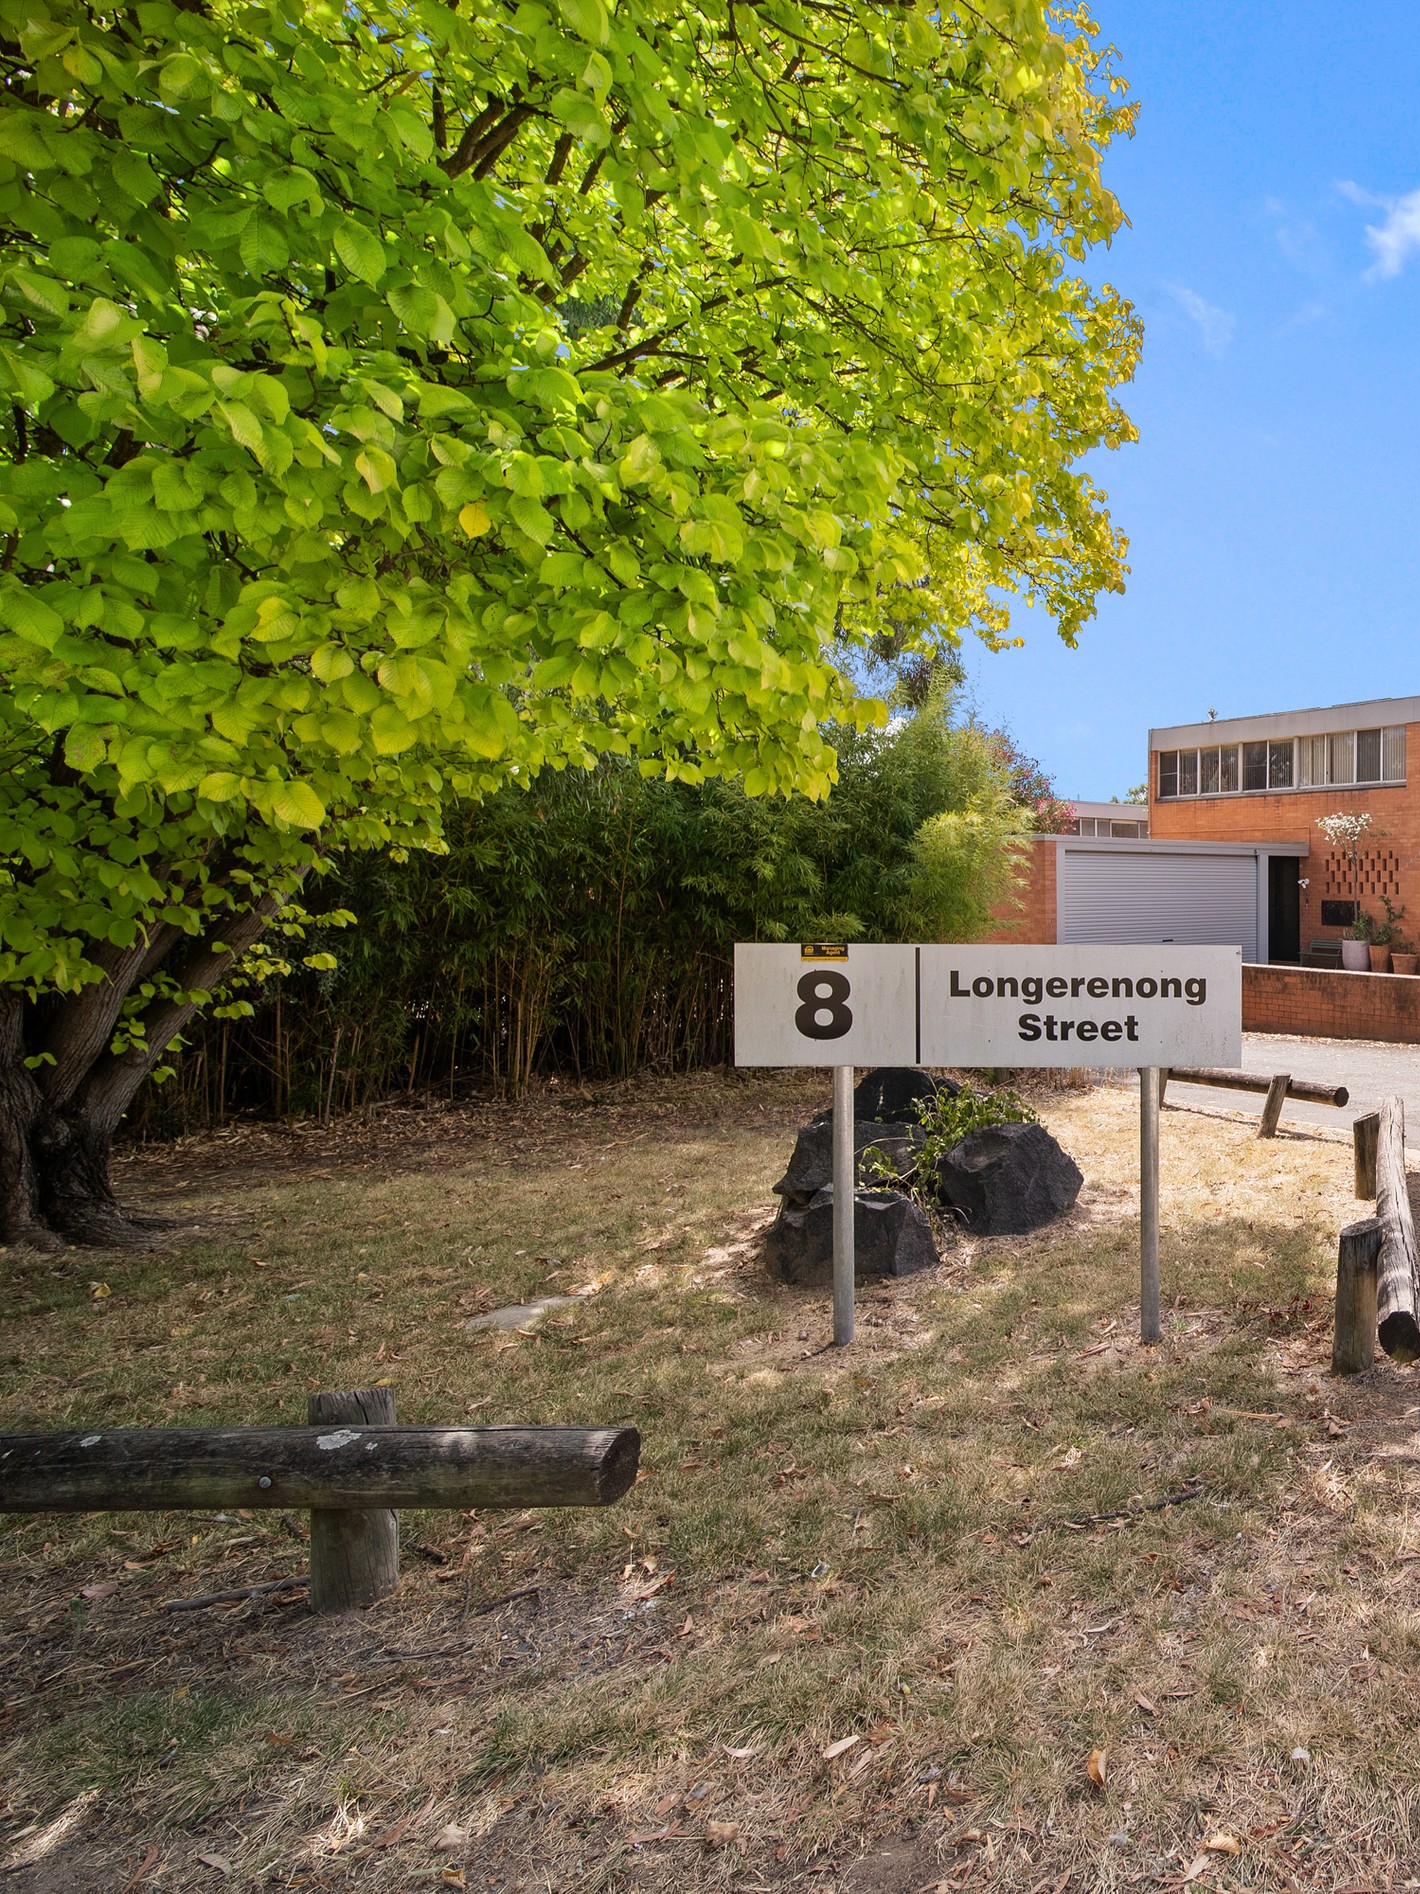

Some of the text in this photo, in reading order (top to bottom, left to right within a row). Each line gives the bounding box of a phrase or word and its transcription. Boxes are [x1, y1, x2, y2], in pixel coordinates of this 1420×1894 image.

[794, 970, 853, 1041] 8
[950, 970, 1208, 1006] Longerenong
[1018, 1013, 1139, 1042] Street
